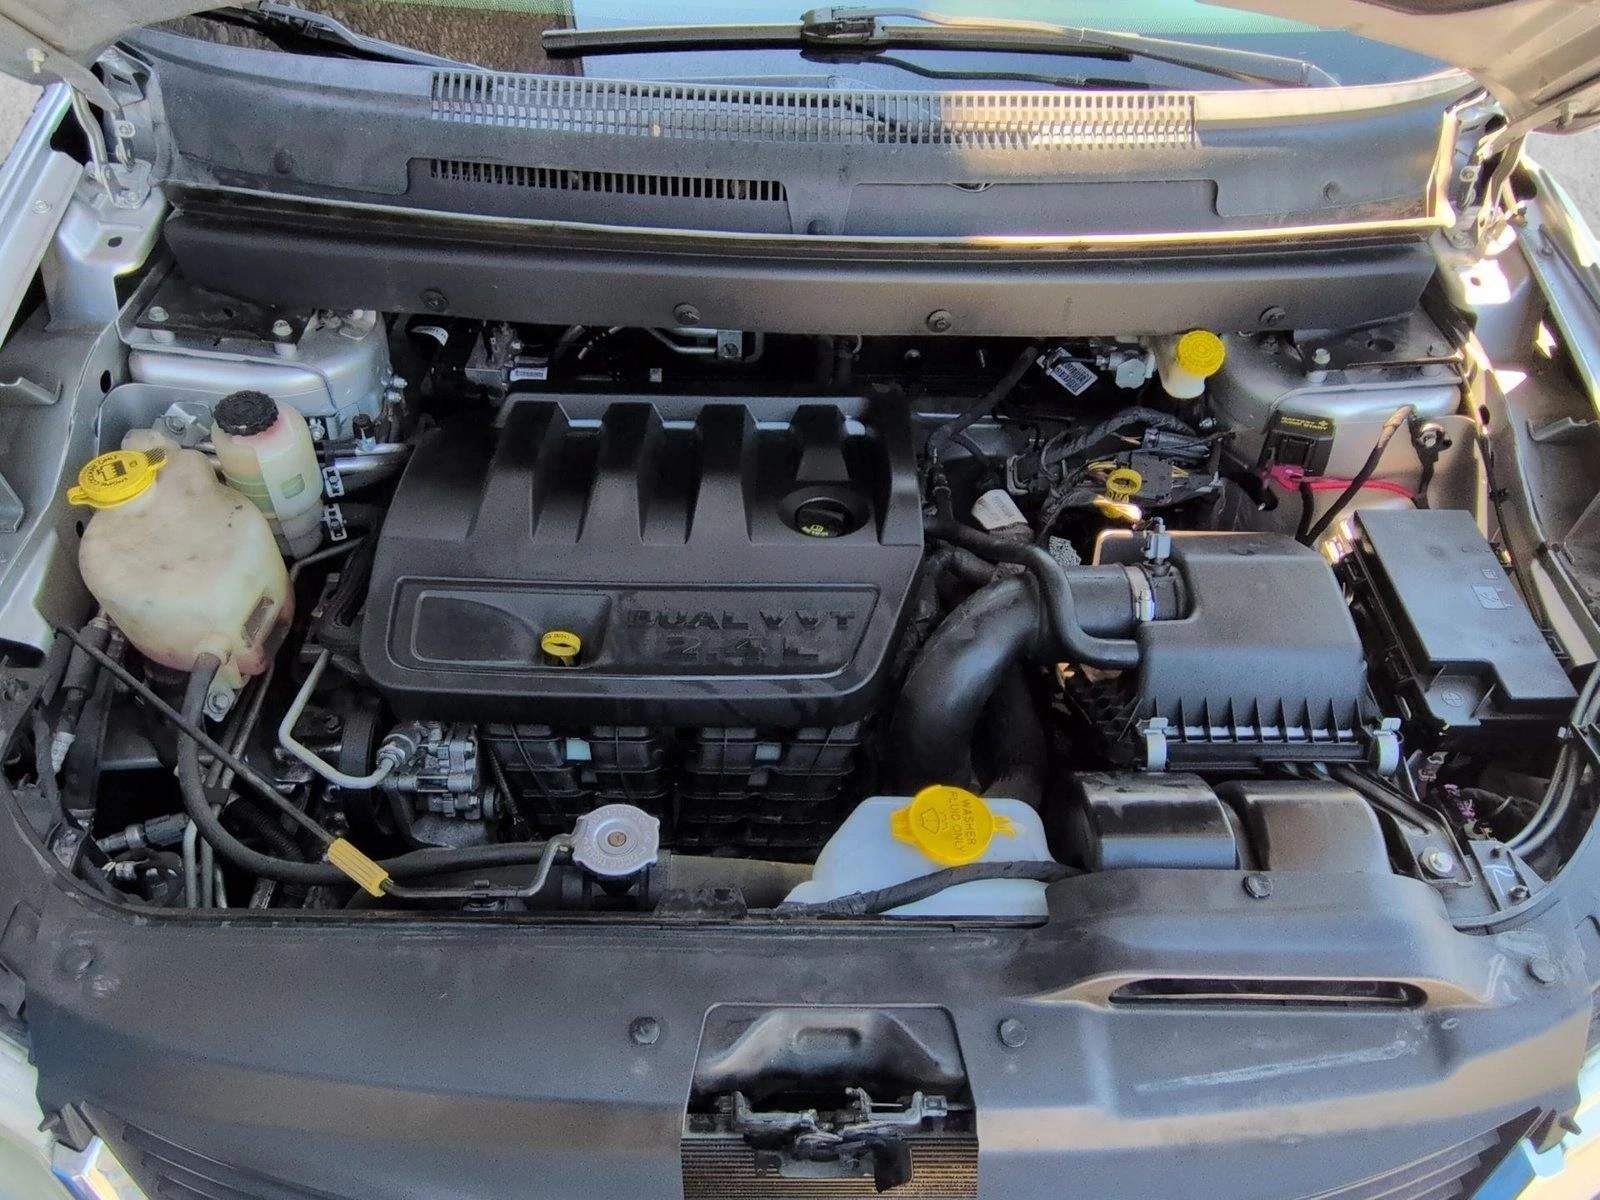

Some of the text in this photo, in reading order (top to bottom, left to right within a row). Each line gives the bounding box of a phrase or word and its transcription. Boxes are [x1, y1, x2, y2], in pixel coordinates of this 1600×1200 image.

[628, 609, 855, 630] DUAL VVT
[664, 635, 819, 662] 2.4L
[948, 791, 967, 853] FLUID ONLY
[961, 799, 977, 847] WASHER
